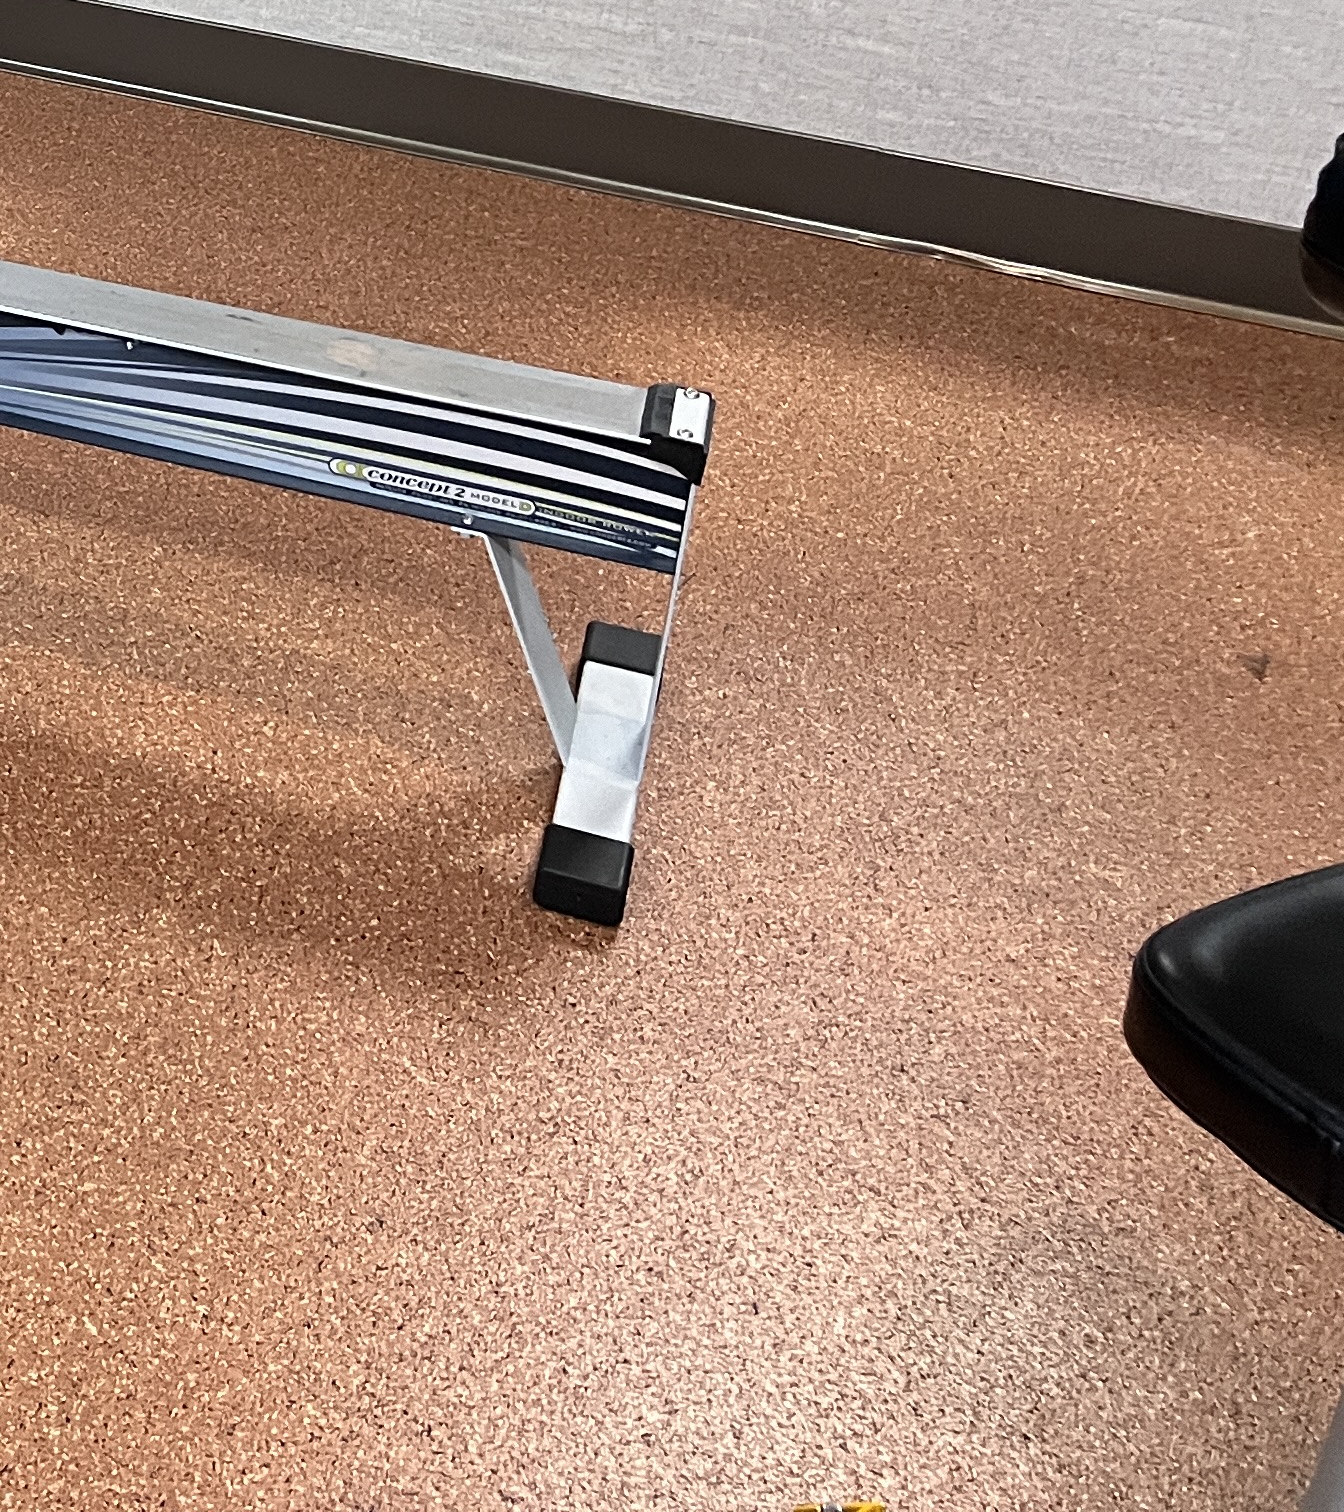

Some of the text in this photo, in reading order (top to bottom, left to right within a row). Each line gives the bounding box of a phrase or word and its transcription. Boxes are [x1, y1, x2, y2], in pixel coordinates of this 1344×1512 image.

[367, 468, 453, 496] concept
[454, 487, 466, 498] 2
[470, 491, 518, 509] MODEL
